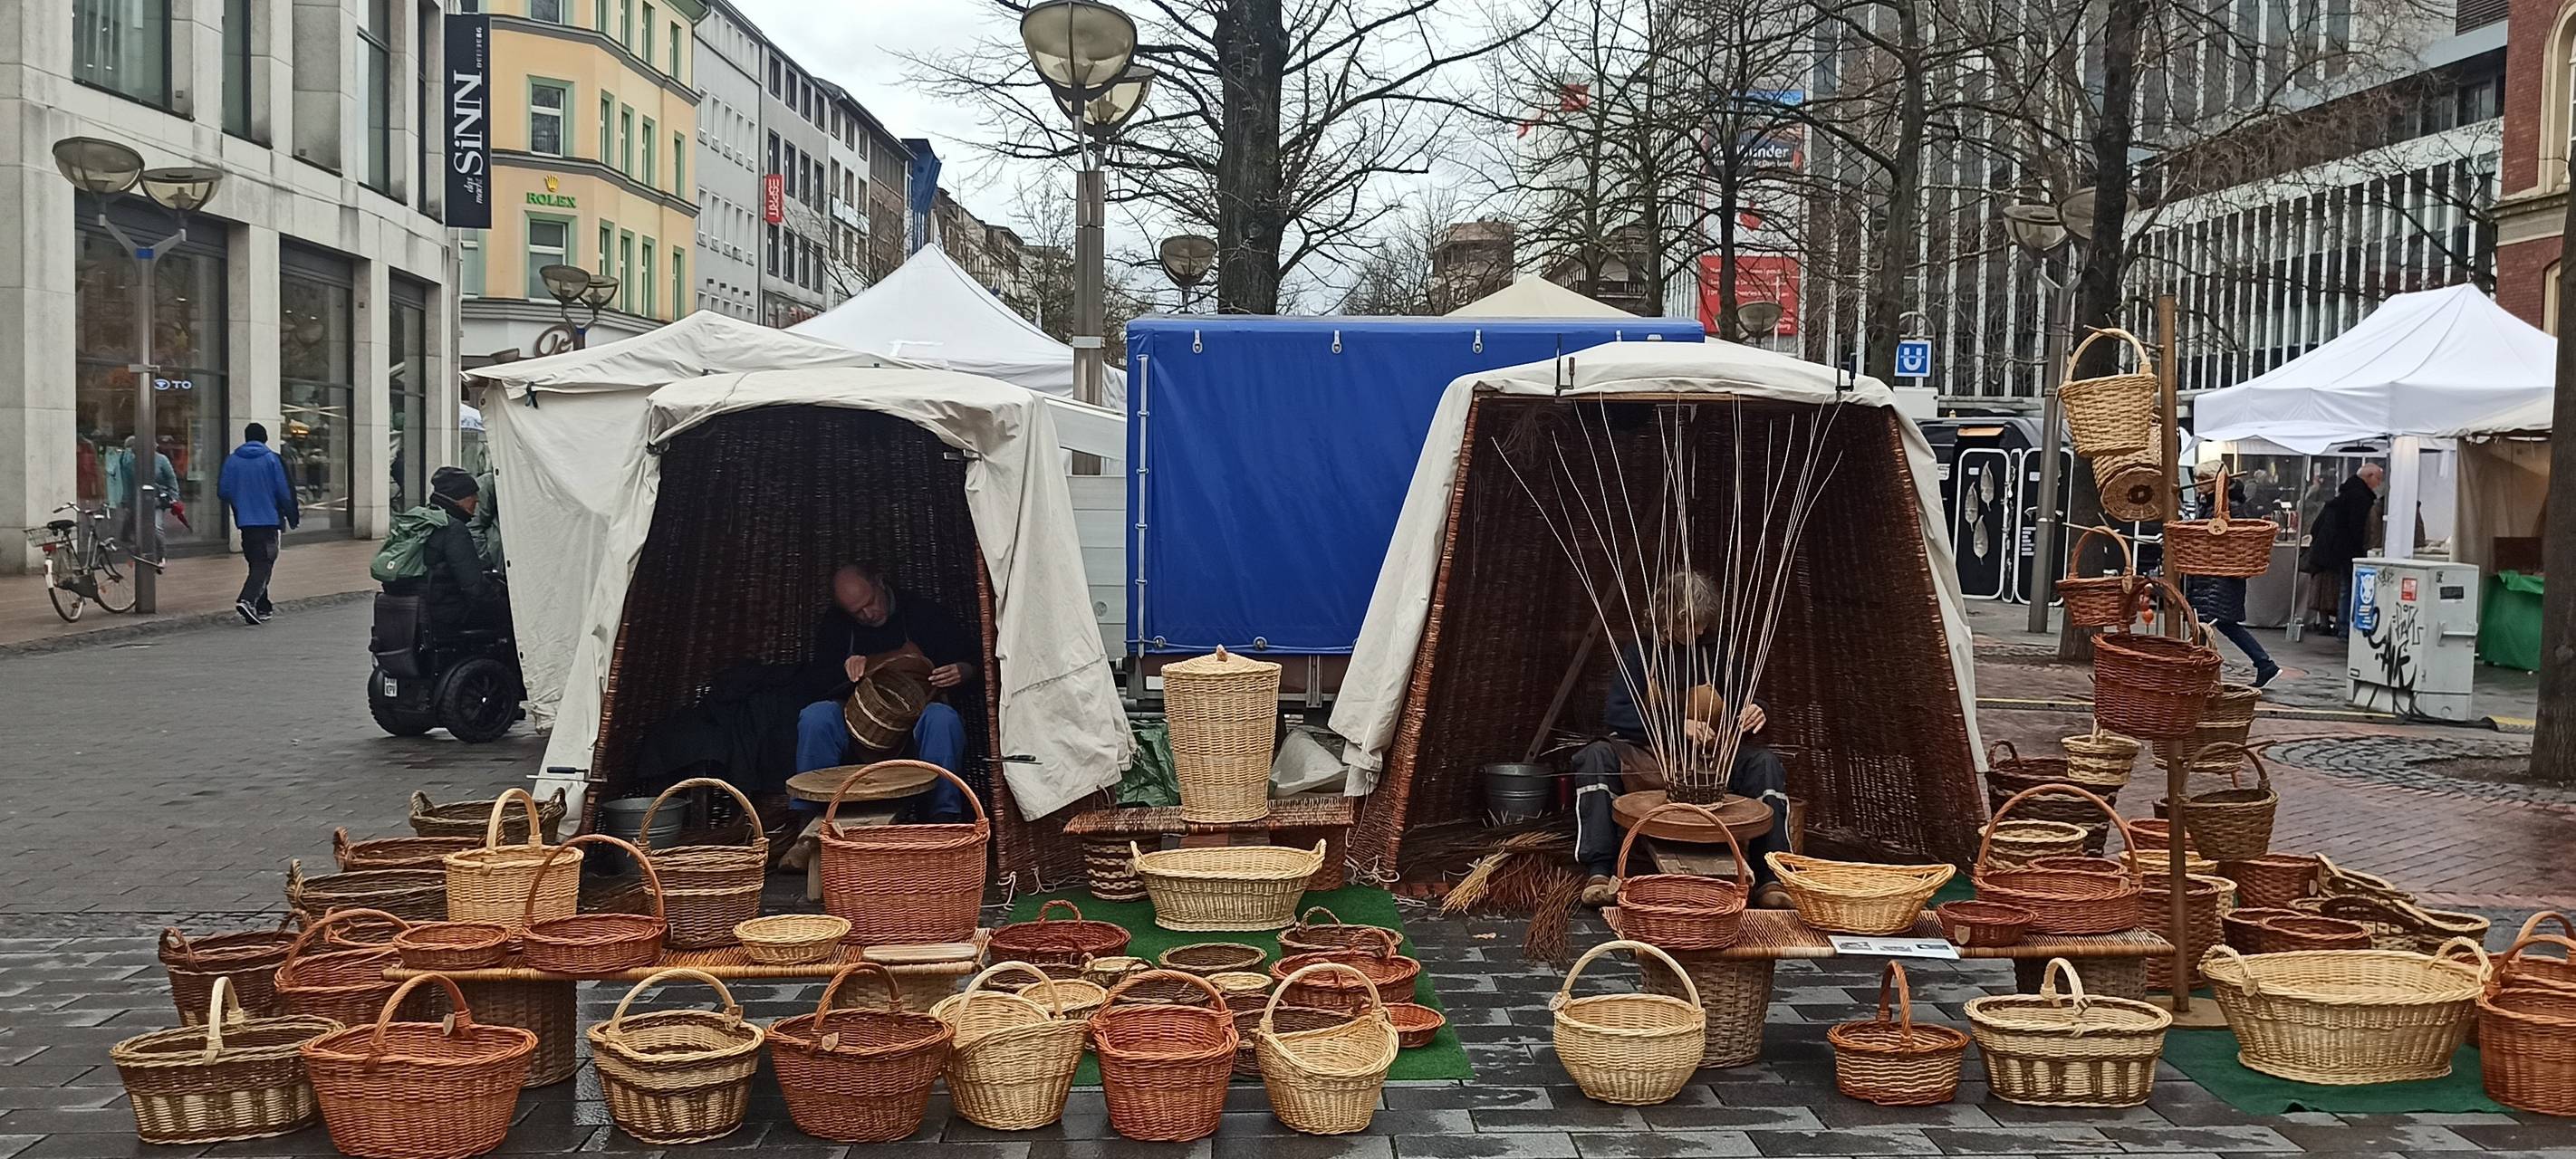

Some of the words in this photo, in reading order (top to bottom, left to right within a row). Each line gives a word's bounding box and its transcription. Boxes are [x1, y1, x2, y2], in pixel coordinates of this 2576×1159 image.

[454, 70, 483, 176] SiNN
[526, 192, 577, 208] ROLEX
[768, 178, 779, 218] ESPRIT
